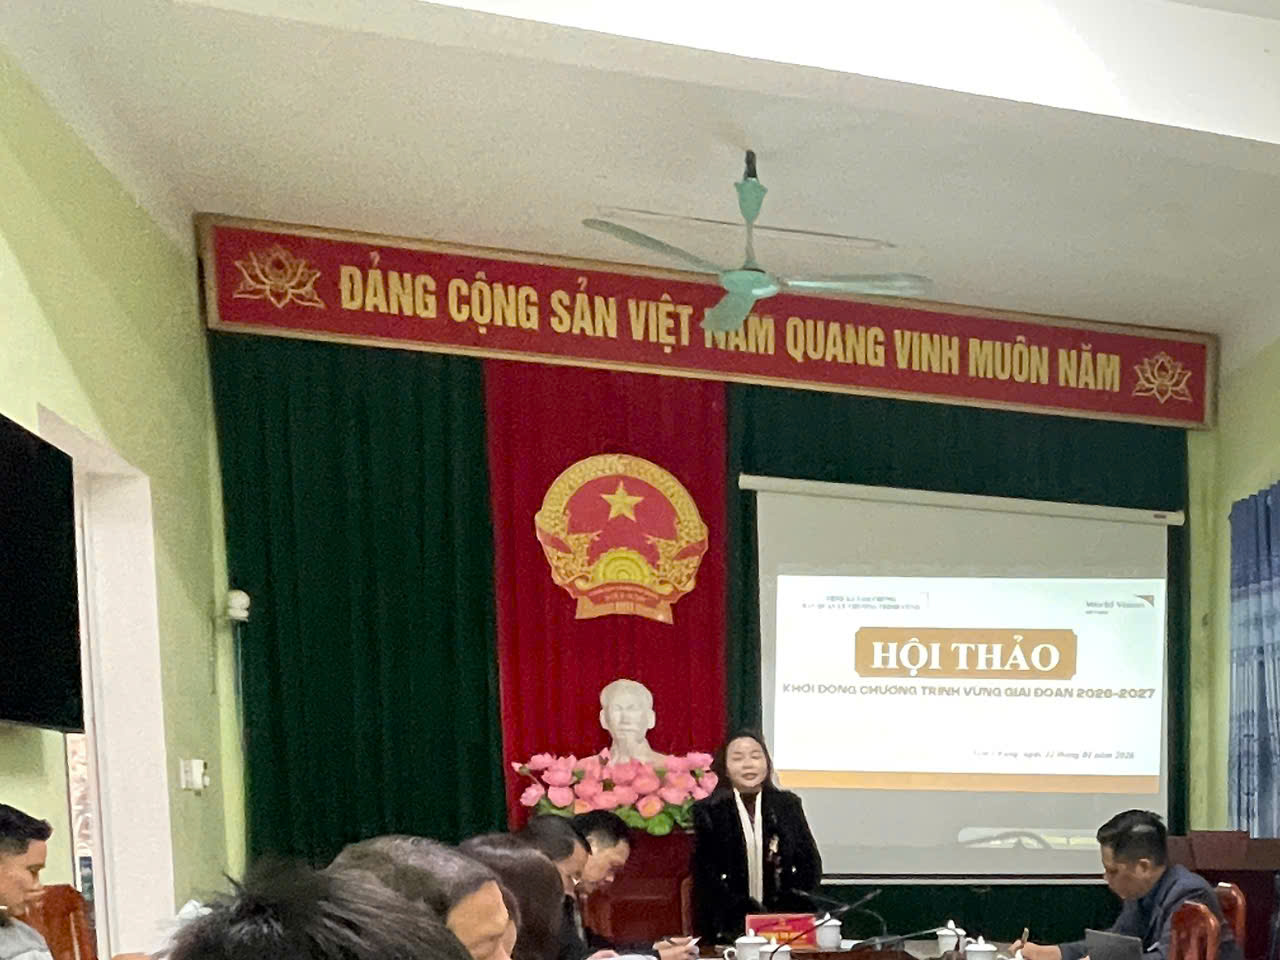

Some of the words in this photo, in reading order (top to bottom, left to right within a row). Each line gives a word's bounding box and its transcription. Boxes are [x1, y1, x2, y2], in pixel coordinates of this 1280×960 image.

[339, 251, 438, 318] ĐẢNG
[447, 271, 540, 334] CỘNG
[550, 276, 619, 339] SẢN
[629, 293, 693, 353] VIỆT
[785, 316, 886, 367] QUANG
[893, 329, 960, 375] VINH
[968, 335, 1050, 385] MUÔN
[1058, 342, 1121, 392] NĂM
[871, 637, 942, 677] HỘI
[951, 634, 1061, 672] THẢO
